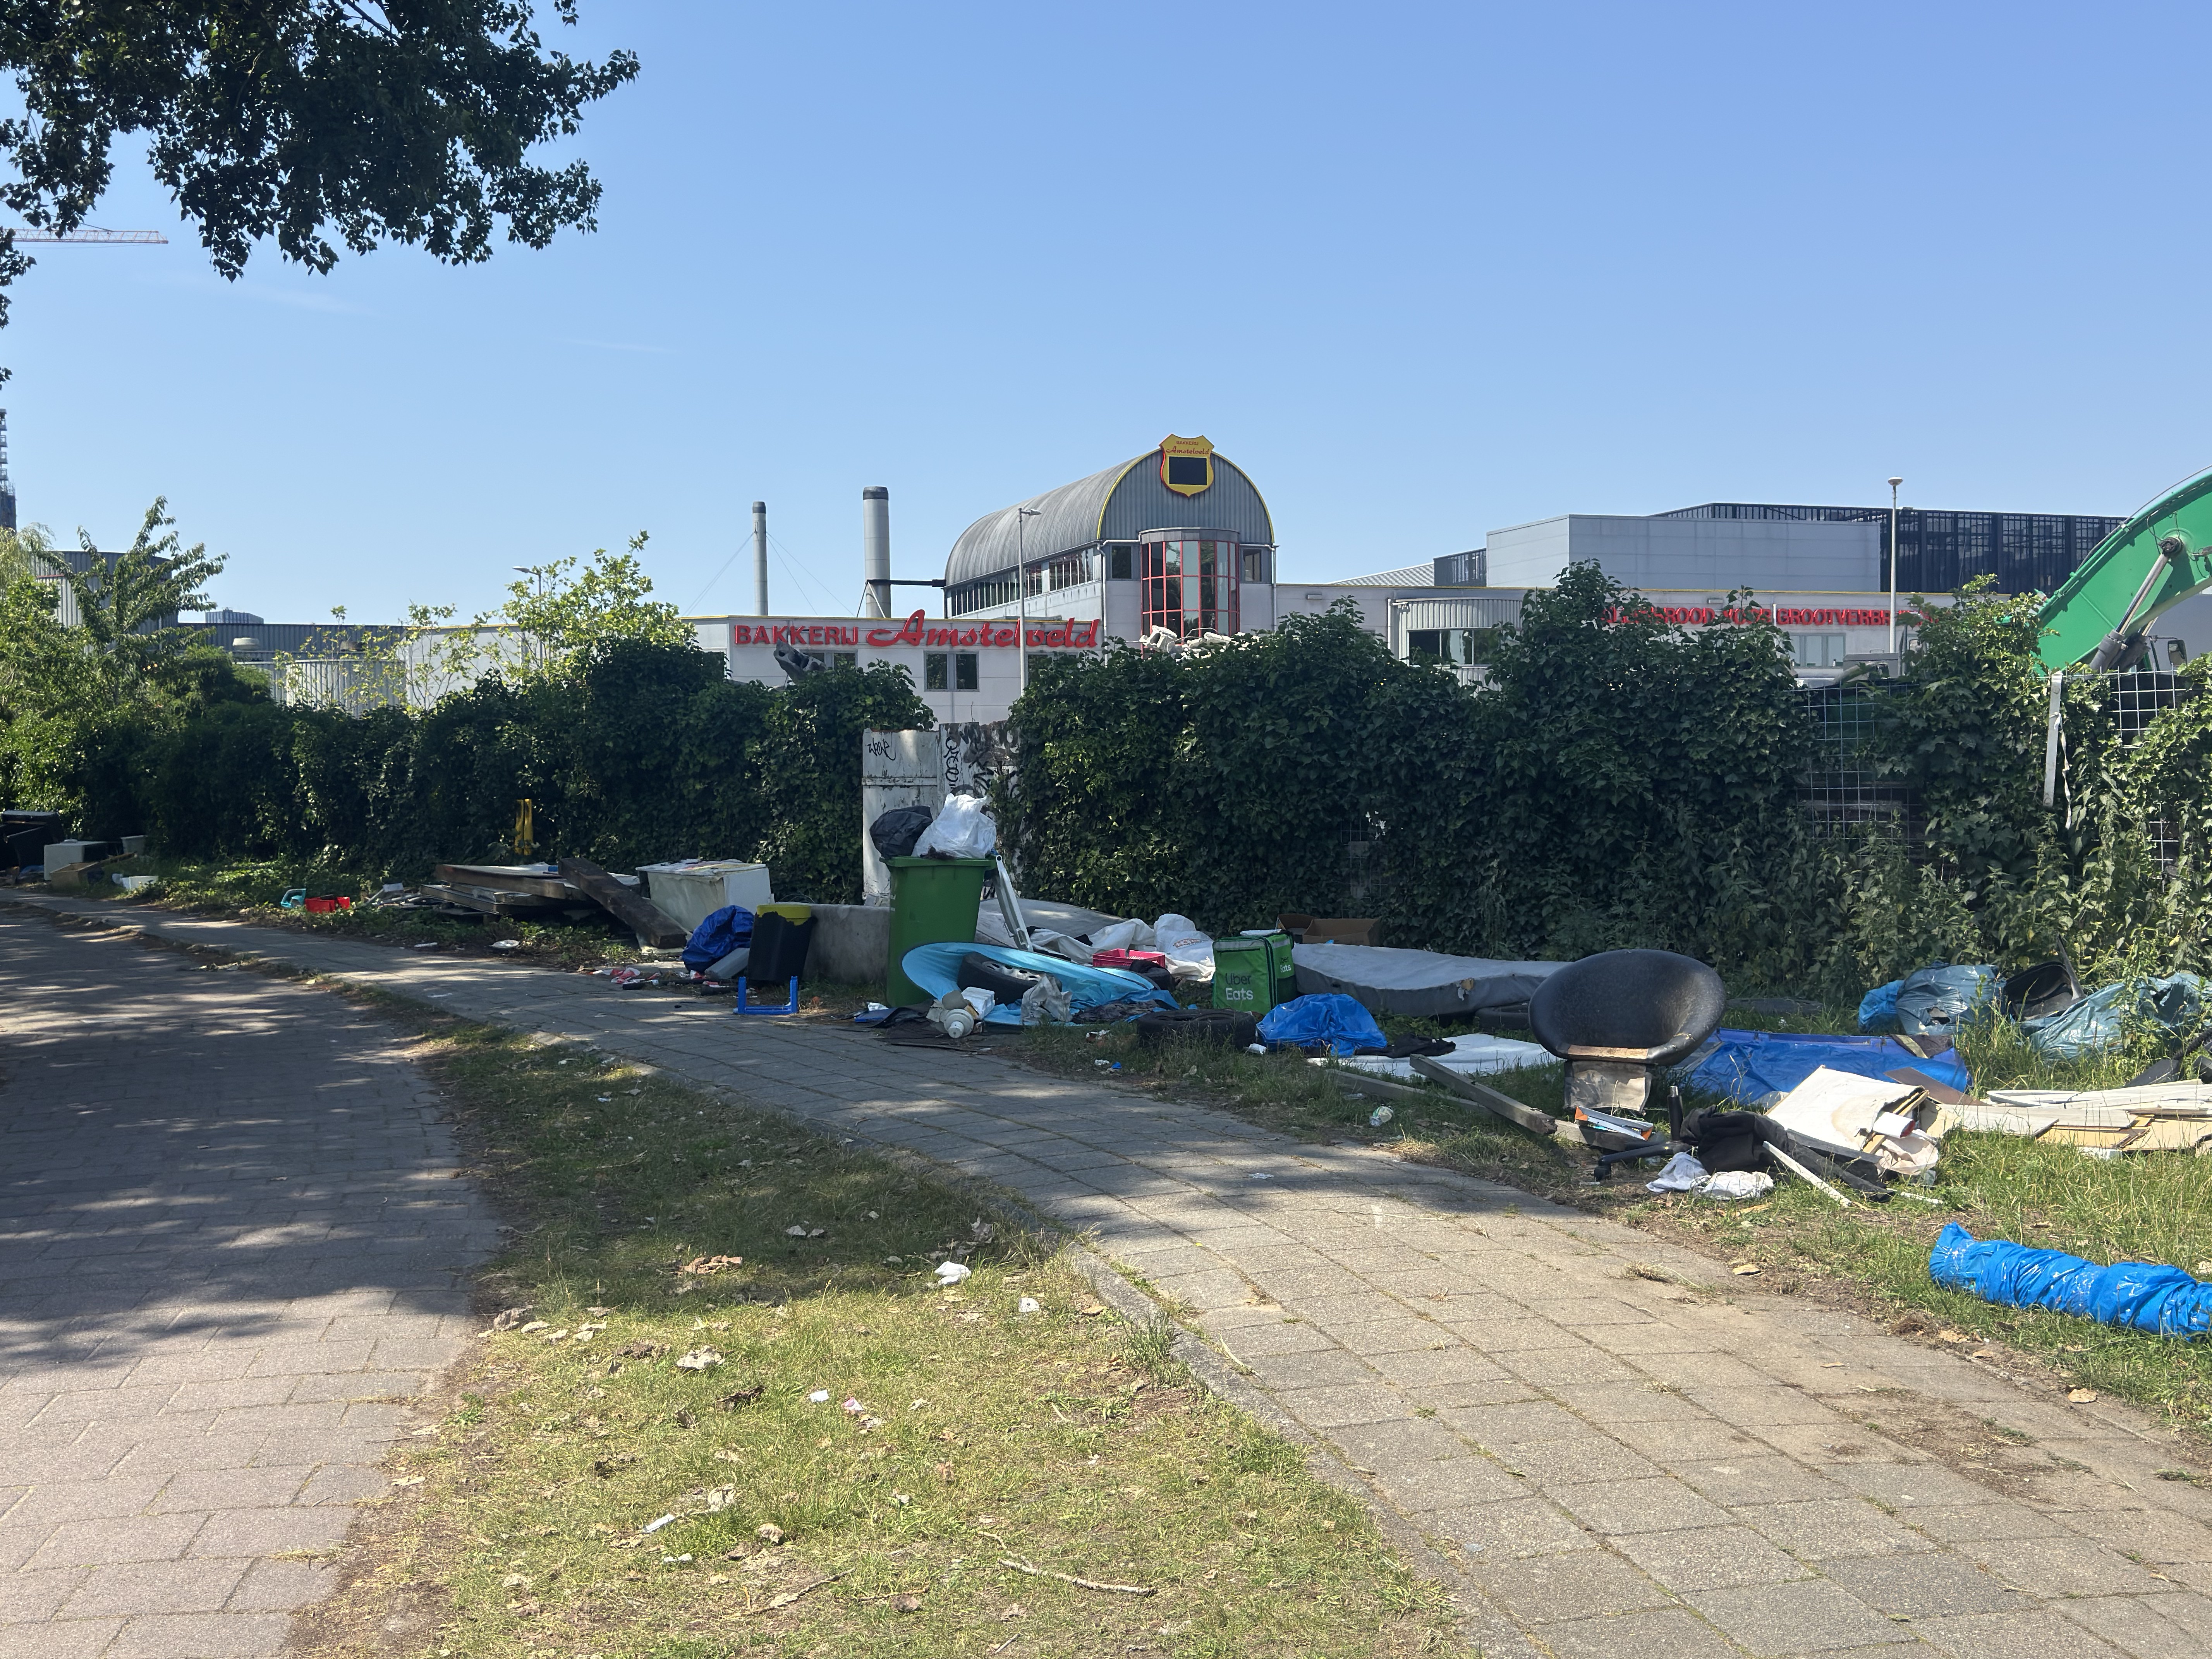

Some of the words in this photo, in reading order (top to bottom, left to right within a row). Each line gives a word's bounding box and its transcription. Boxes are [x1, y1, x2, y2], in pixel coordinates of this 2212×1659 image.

[1166, 446, 1209, 454] Amstelveld
[735, 625, 859, 645] BAKKERIJ
[867, 609, 1100, 648] Amstelveld
[1225, 973, 1252, 985] Uber
[1226, 988, 1254, 1000] Eats
